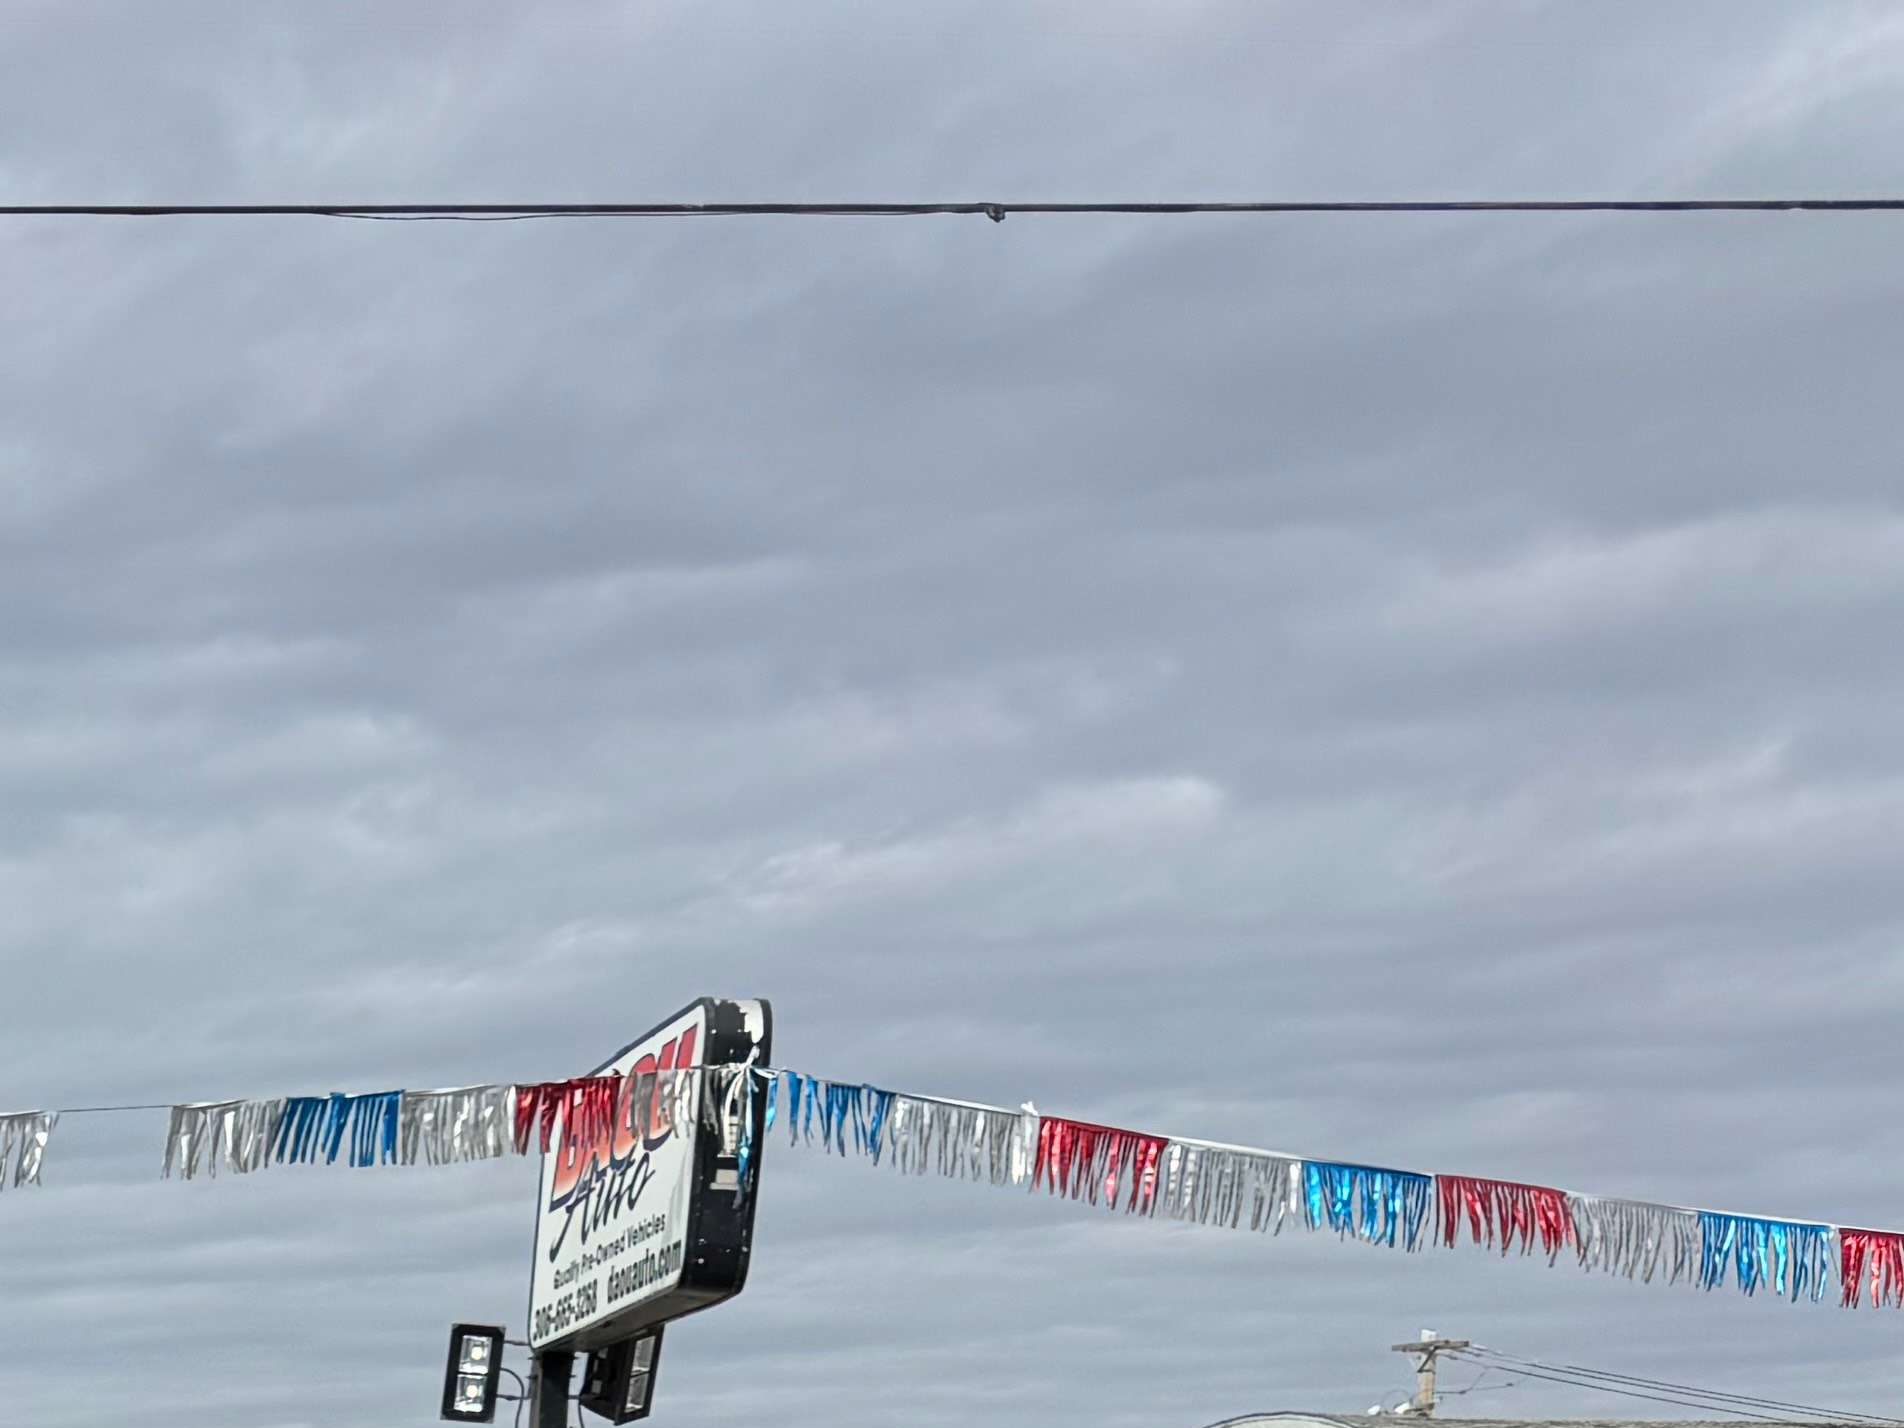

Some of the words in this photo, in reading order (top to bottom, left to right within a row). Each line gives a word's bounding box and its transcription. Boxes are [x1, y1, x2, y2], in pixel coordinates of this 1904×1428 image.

[550, 1152, 655, 1263] Auto
[582, 1236, 625, 1275] Pre-Owned
[627, 1213, 666, 1249] Vehicles
[607, 1239, 682, 1305] daouauto.com
